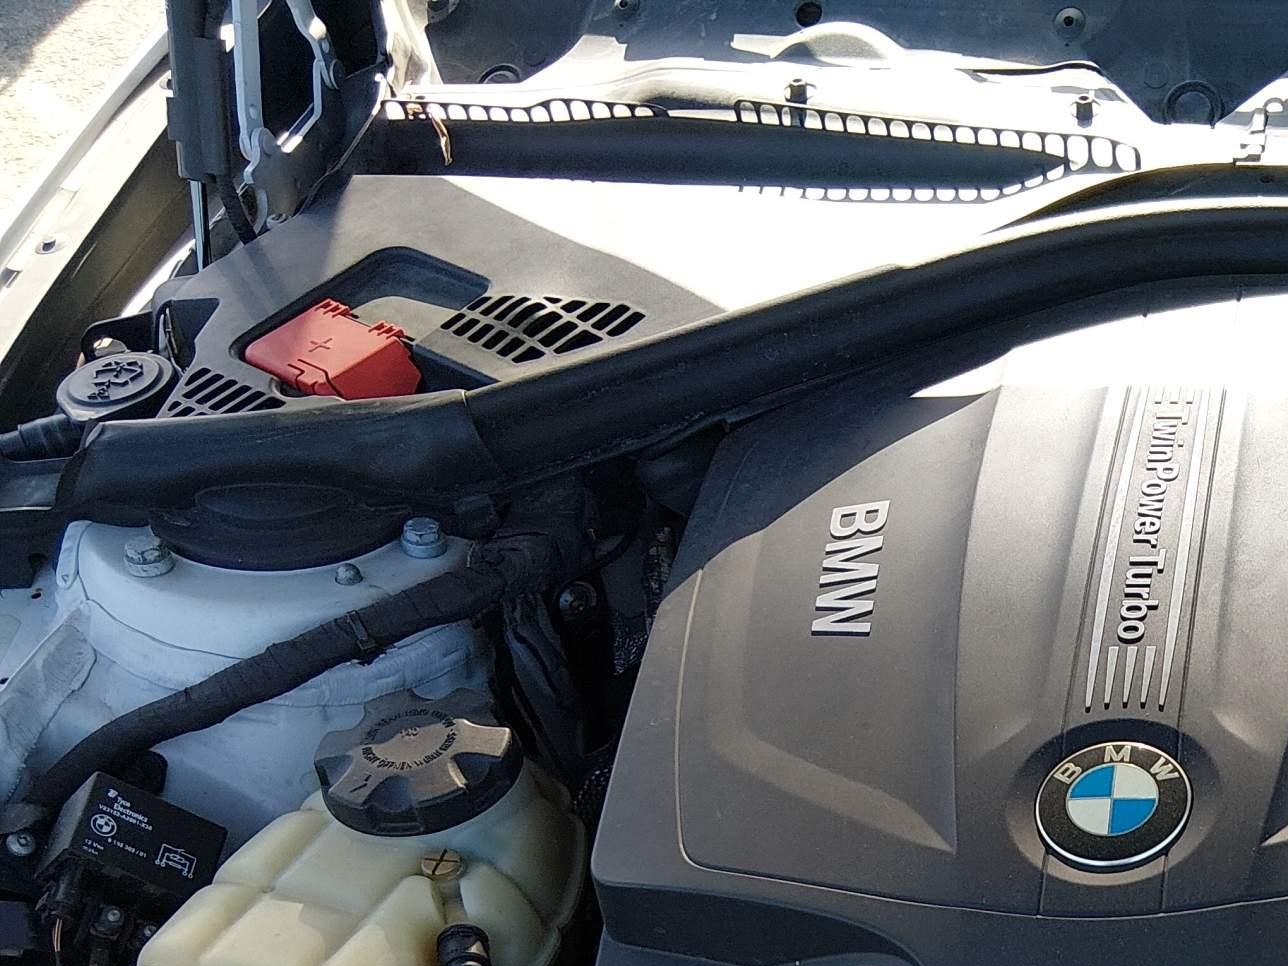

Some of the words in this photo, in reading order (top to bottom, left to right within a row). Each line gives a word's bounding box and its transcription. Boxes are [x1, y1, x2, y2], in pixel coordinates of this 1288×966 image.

[1133, 405, 1193, 549] TwinPower
[811, 500, 890, 637] BMW
[1117, 548, 1168, 645] Turbo
[114, 803, 148, 823] Electronics
[1053, 744, 1180, 785] BMW
